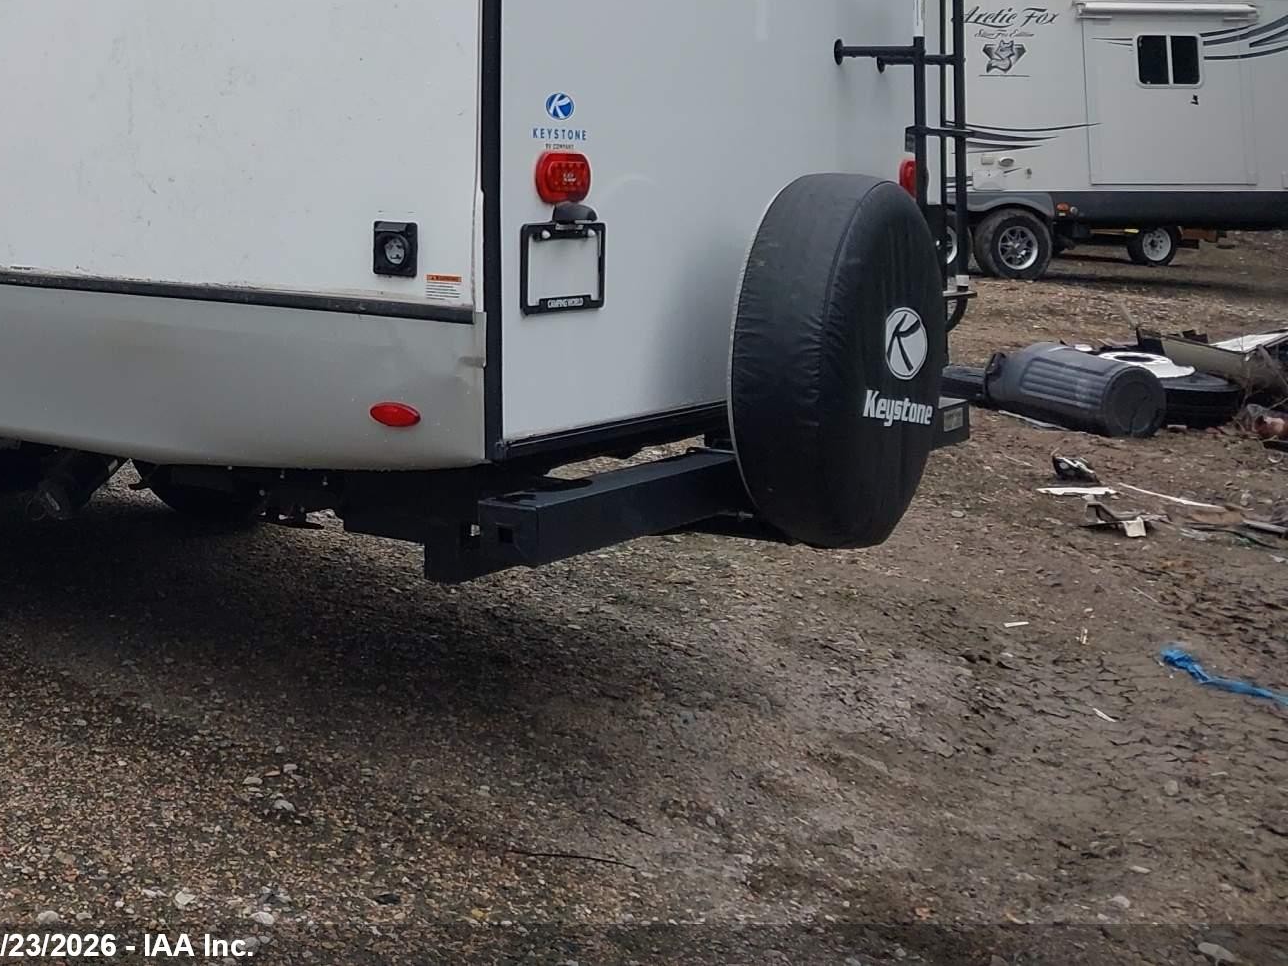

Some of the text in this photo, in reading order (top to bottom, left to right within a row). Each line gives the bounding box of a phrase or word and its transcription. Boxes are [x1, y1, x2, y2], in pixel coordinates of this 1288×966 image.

[1020, 7, 1059, 27] Fox
[532, 128, 587, 141] KEYSTONE
[863, 389, 933, 427] Keystone
